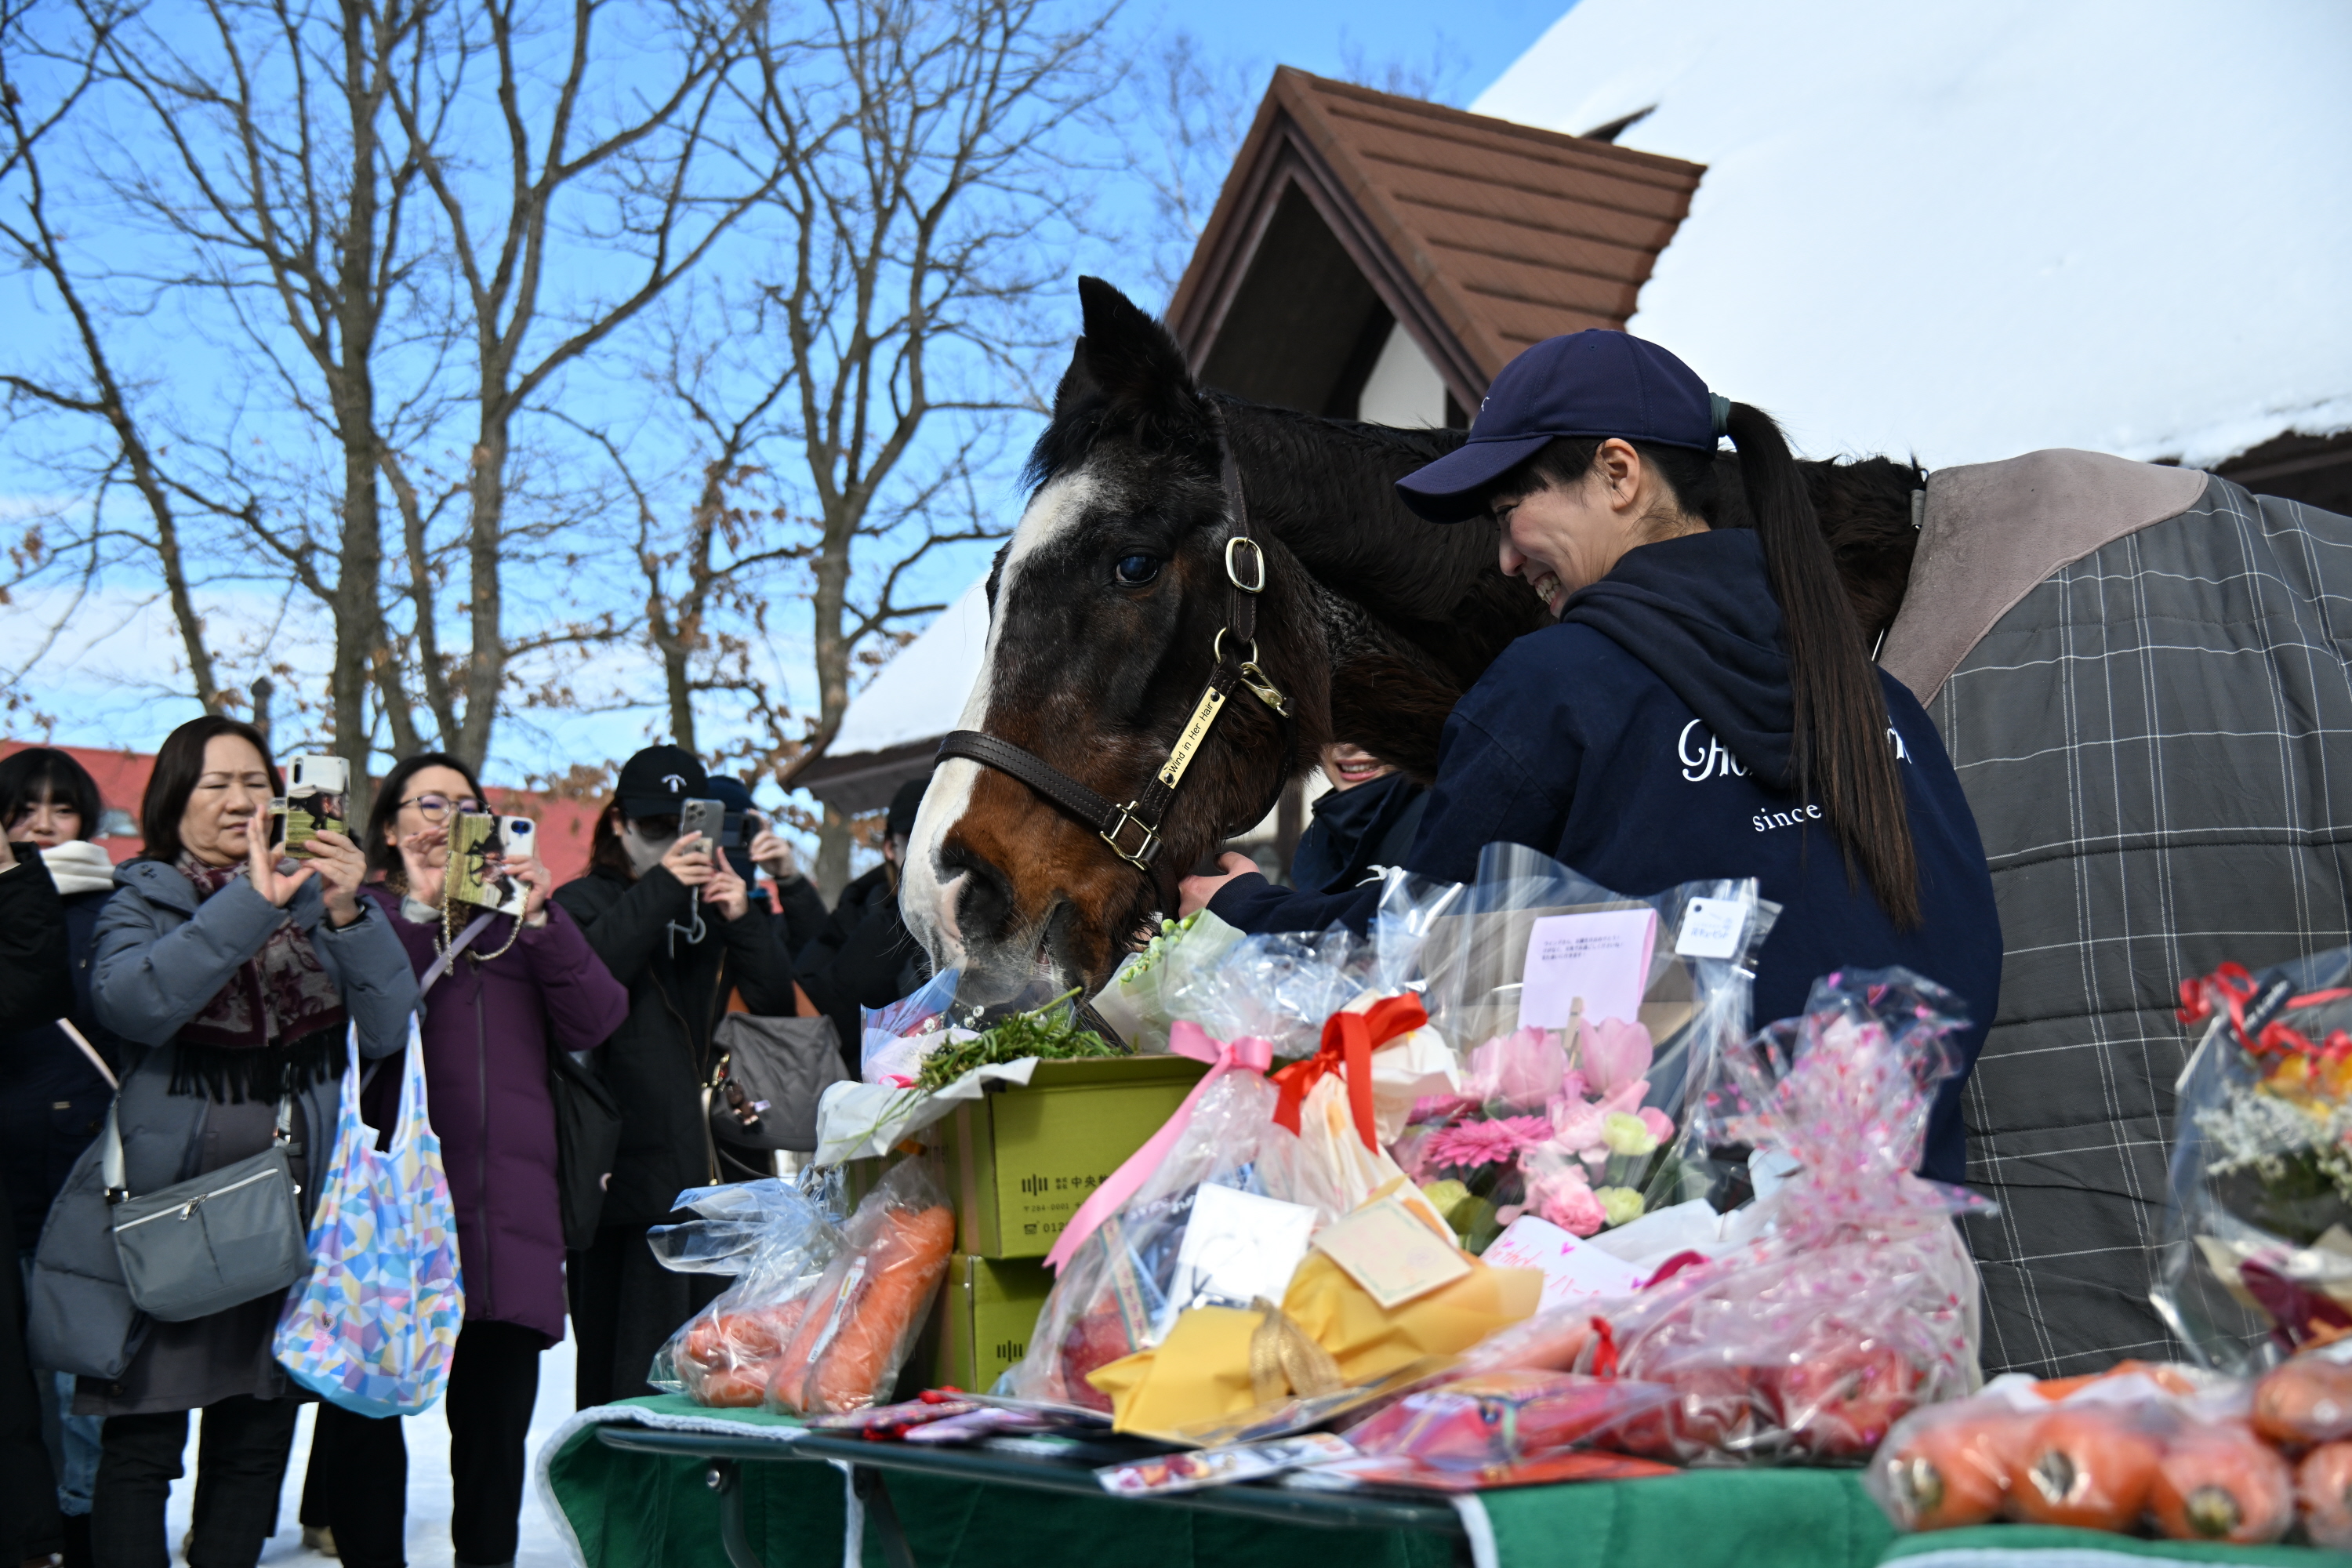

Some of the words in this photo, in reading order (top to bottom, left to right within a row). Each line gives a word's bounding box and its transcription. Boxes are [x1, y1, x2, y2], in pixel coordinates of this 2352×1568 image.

[1169, 751, 1185, 773] Wind
[1181, 742, 1192, 750] in
[1189, 722, 1201, 740] Her
[1199, 702, 1213, 721] Hair
[1752, 804, 1822, 832] since
[1043, 1221, 1069, 1232] 012
